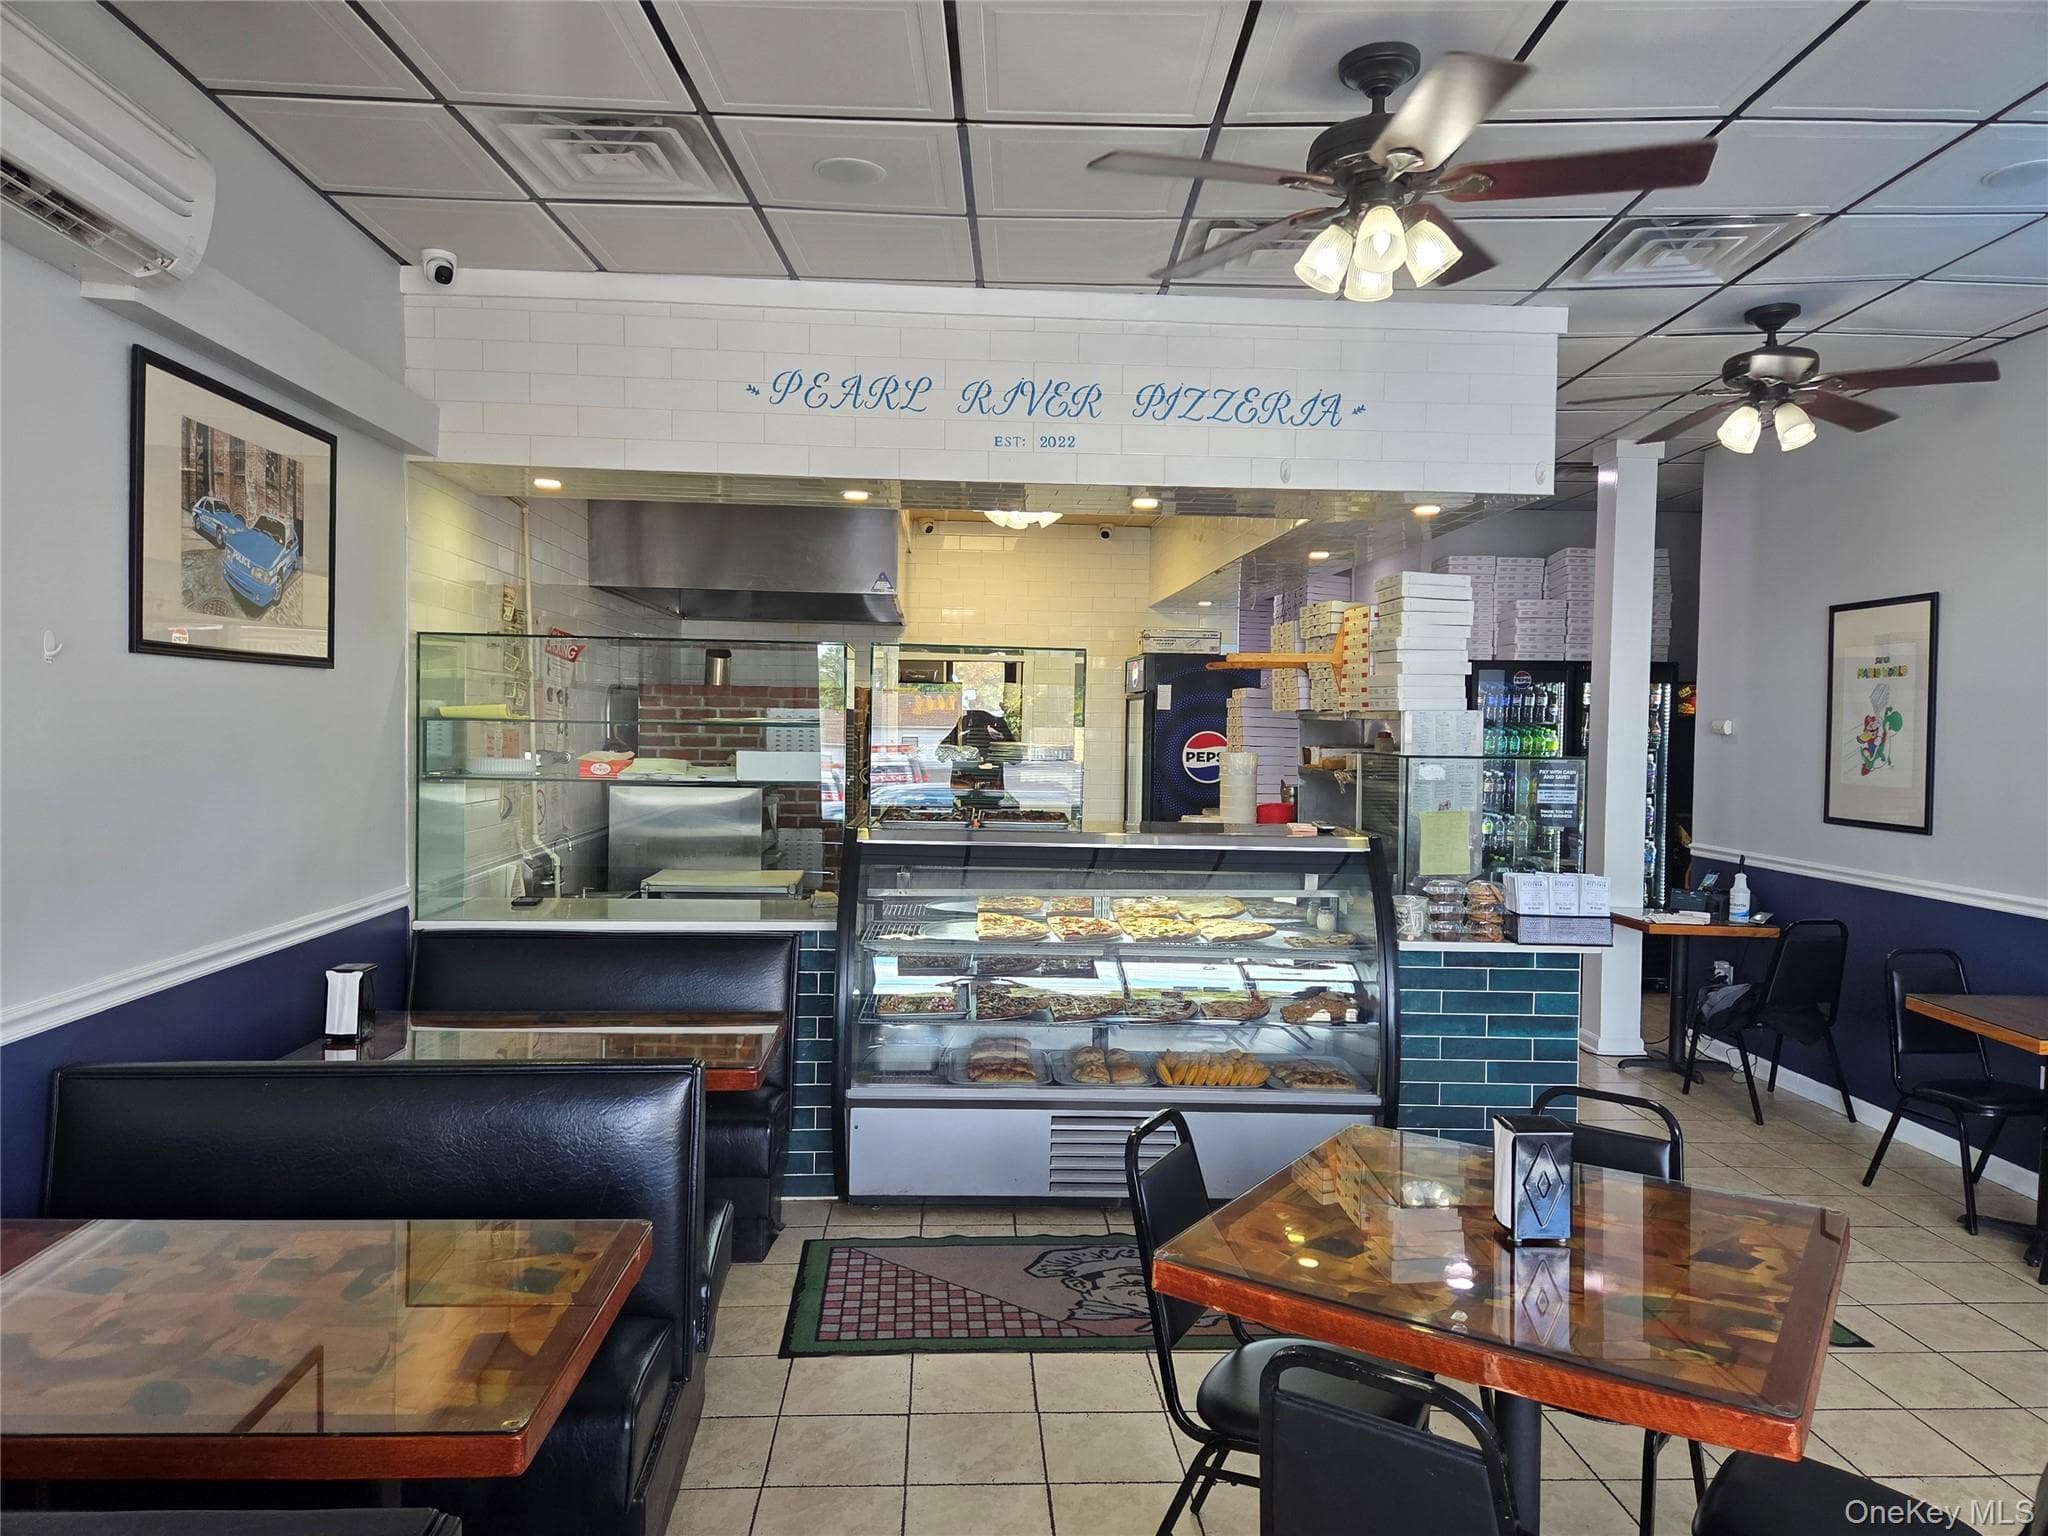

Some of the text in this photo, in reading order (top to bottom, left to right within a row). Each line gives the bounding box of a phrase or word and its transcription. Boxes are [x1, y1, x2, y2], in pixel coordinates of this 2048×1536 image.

[770, 370, 1343, 428] PEARL RIVER PIZZERIA
[994, 436, 1076, 448] EST: 2022
